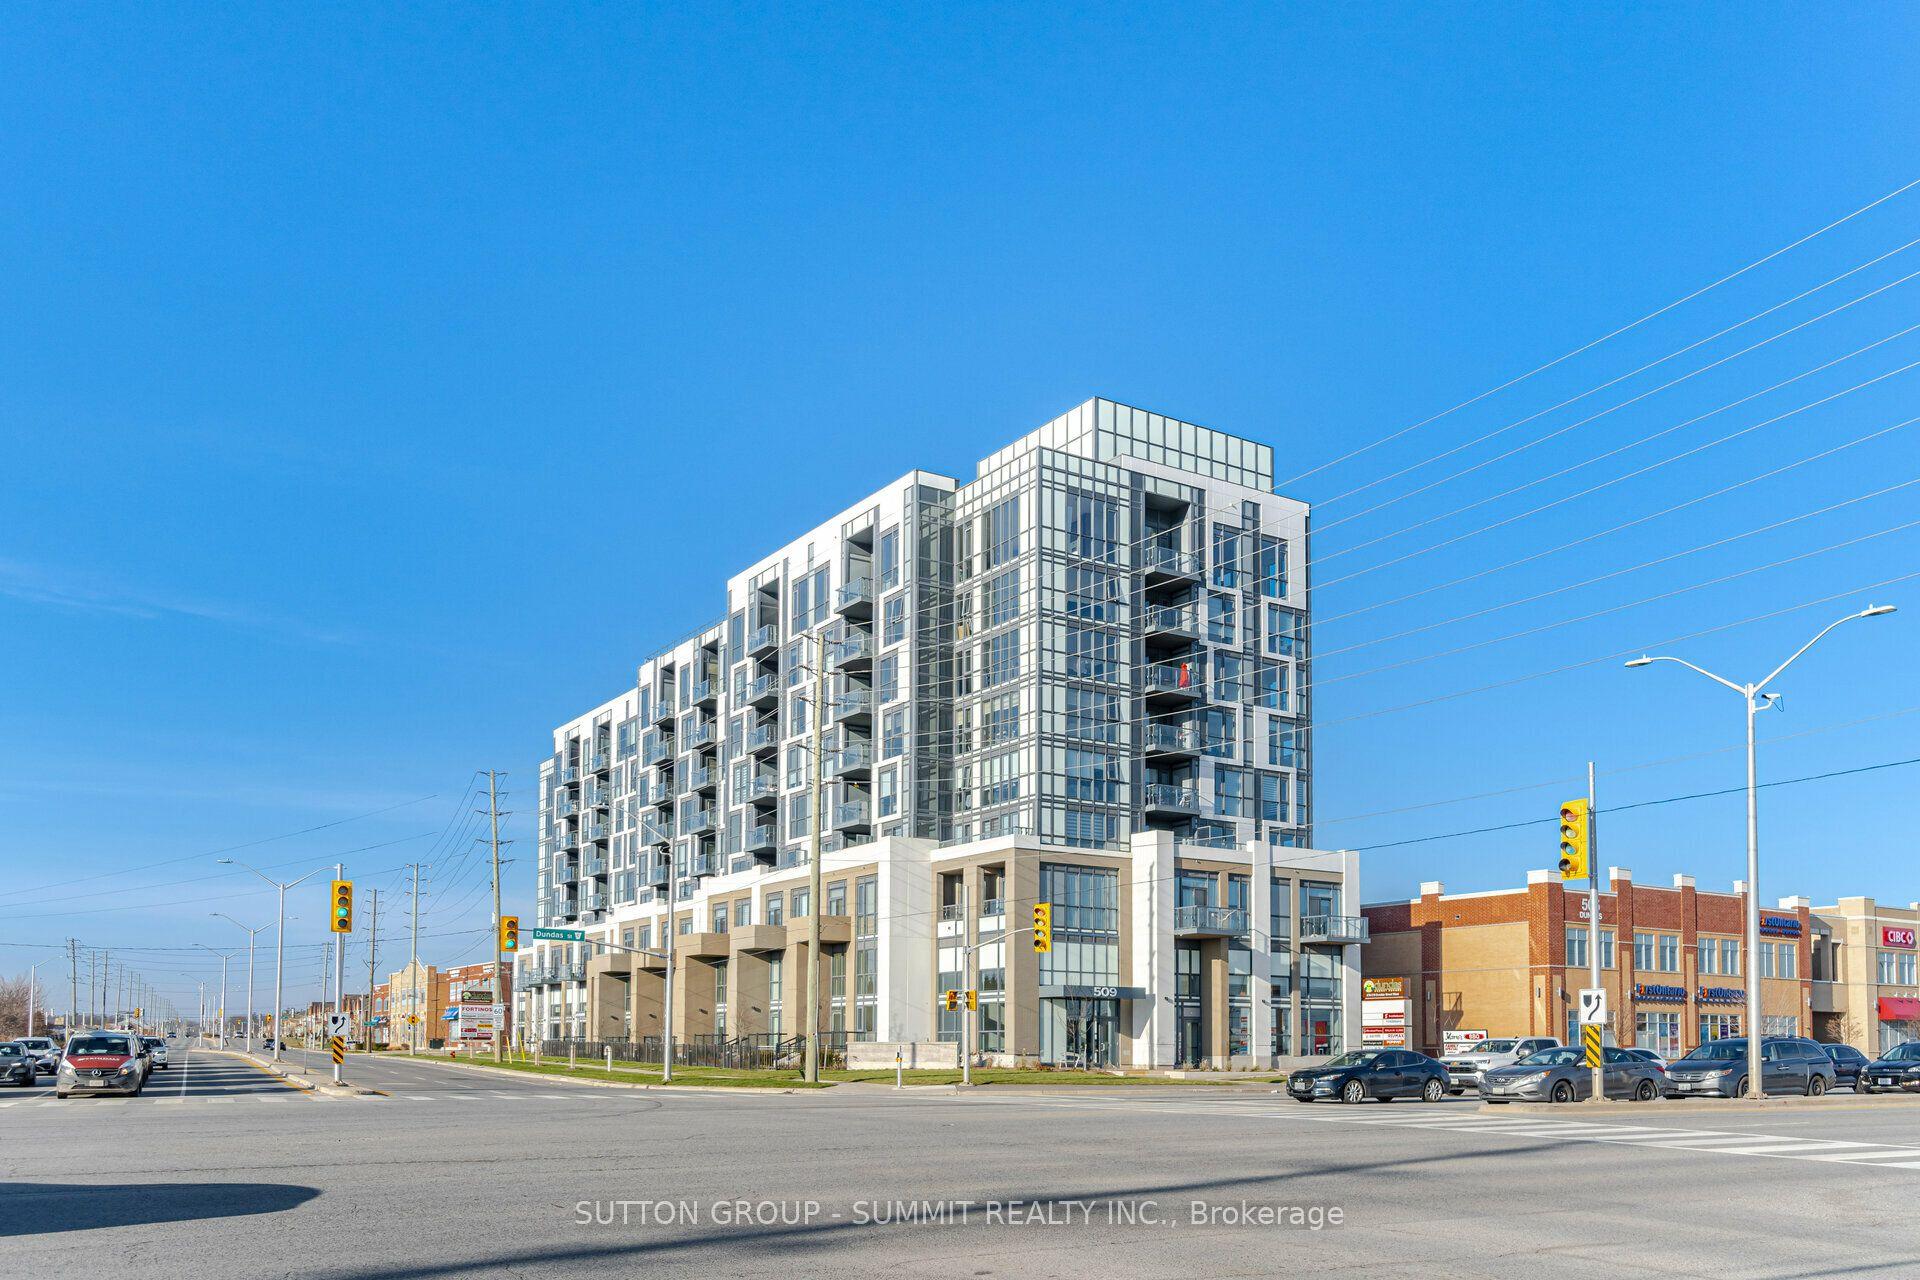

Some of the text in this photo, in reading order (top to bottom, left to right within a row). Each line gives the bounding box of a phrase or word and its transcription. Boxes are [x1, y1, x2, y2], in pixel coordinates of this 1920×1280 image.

[535, 930, 564, 939] Dundas
[1887, 930, 1907, 944] CIBC
[1093, 986, 1118, 997] 509
